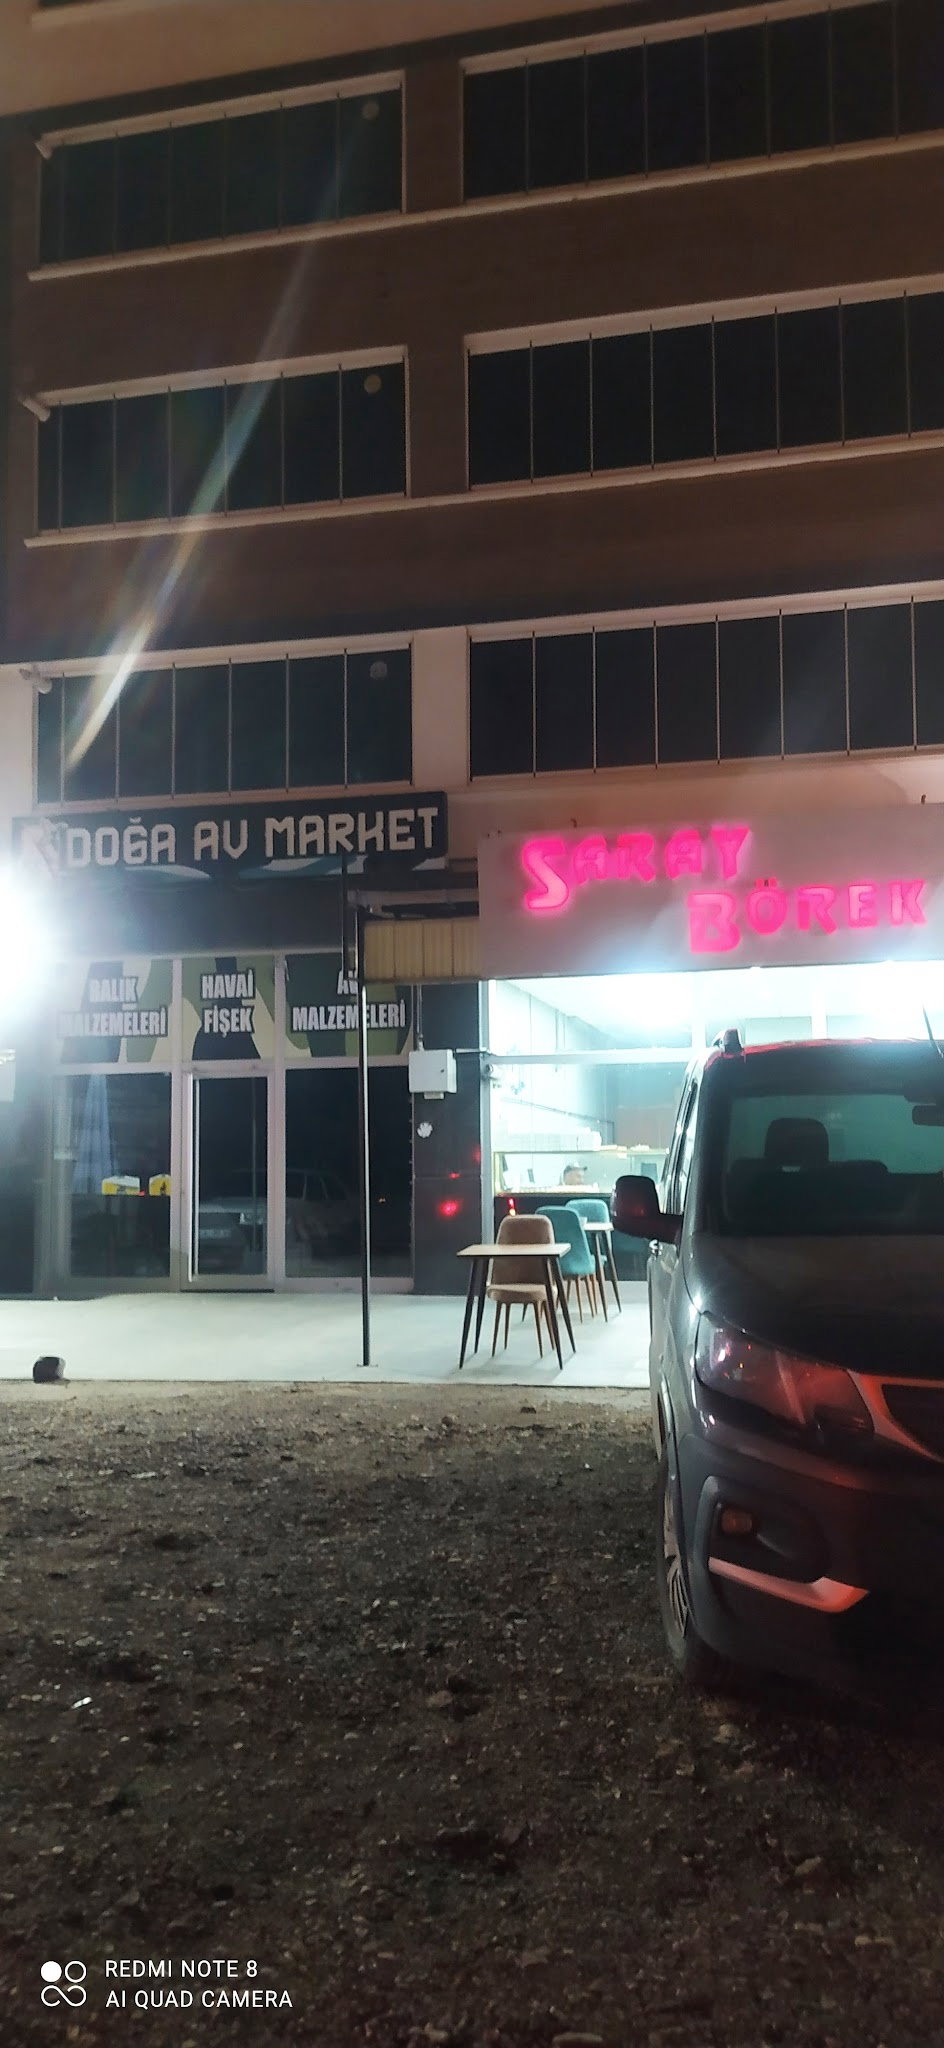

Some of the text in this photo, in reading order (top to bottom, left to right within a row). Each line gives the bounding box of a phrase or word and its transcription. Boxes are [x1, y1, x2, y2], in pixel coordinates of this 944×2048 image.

[66, 807, 438, 867] DOĞA AV MARKET
[522, 826, 752, 911] SARAY
[687, 877, 927, 954] BÖREK
[204, 1005, 253, 1038] FİŞEK
